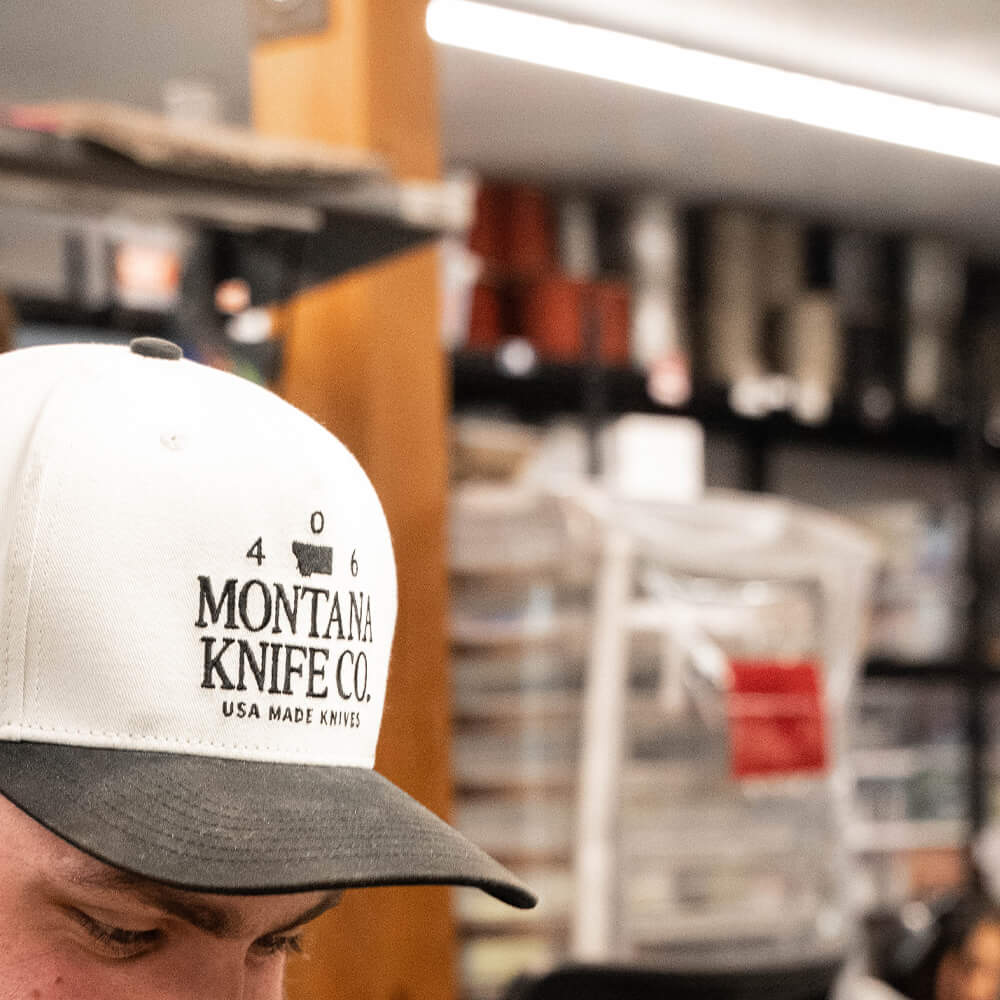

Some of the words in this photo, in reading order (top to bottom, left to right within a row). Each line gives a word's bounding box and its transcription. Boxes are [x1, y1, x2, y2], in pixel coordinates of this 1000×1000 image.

[246, 536, 266, 566] 4
[350, 549, 359, 577] 6
[195, 575, 373, 643] MONTANA
[200, 636, 330, 698] KNIFE
[222, 701, 261, 719] USA
[268, 706, 314, 724] MADE
[320, 709, 361, 728] KNIVES
